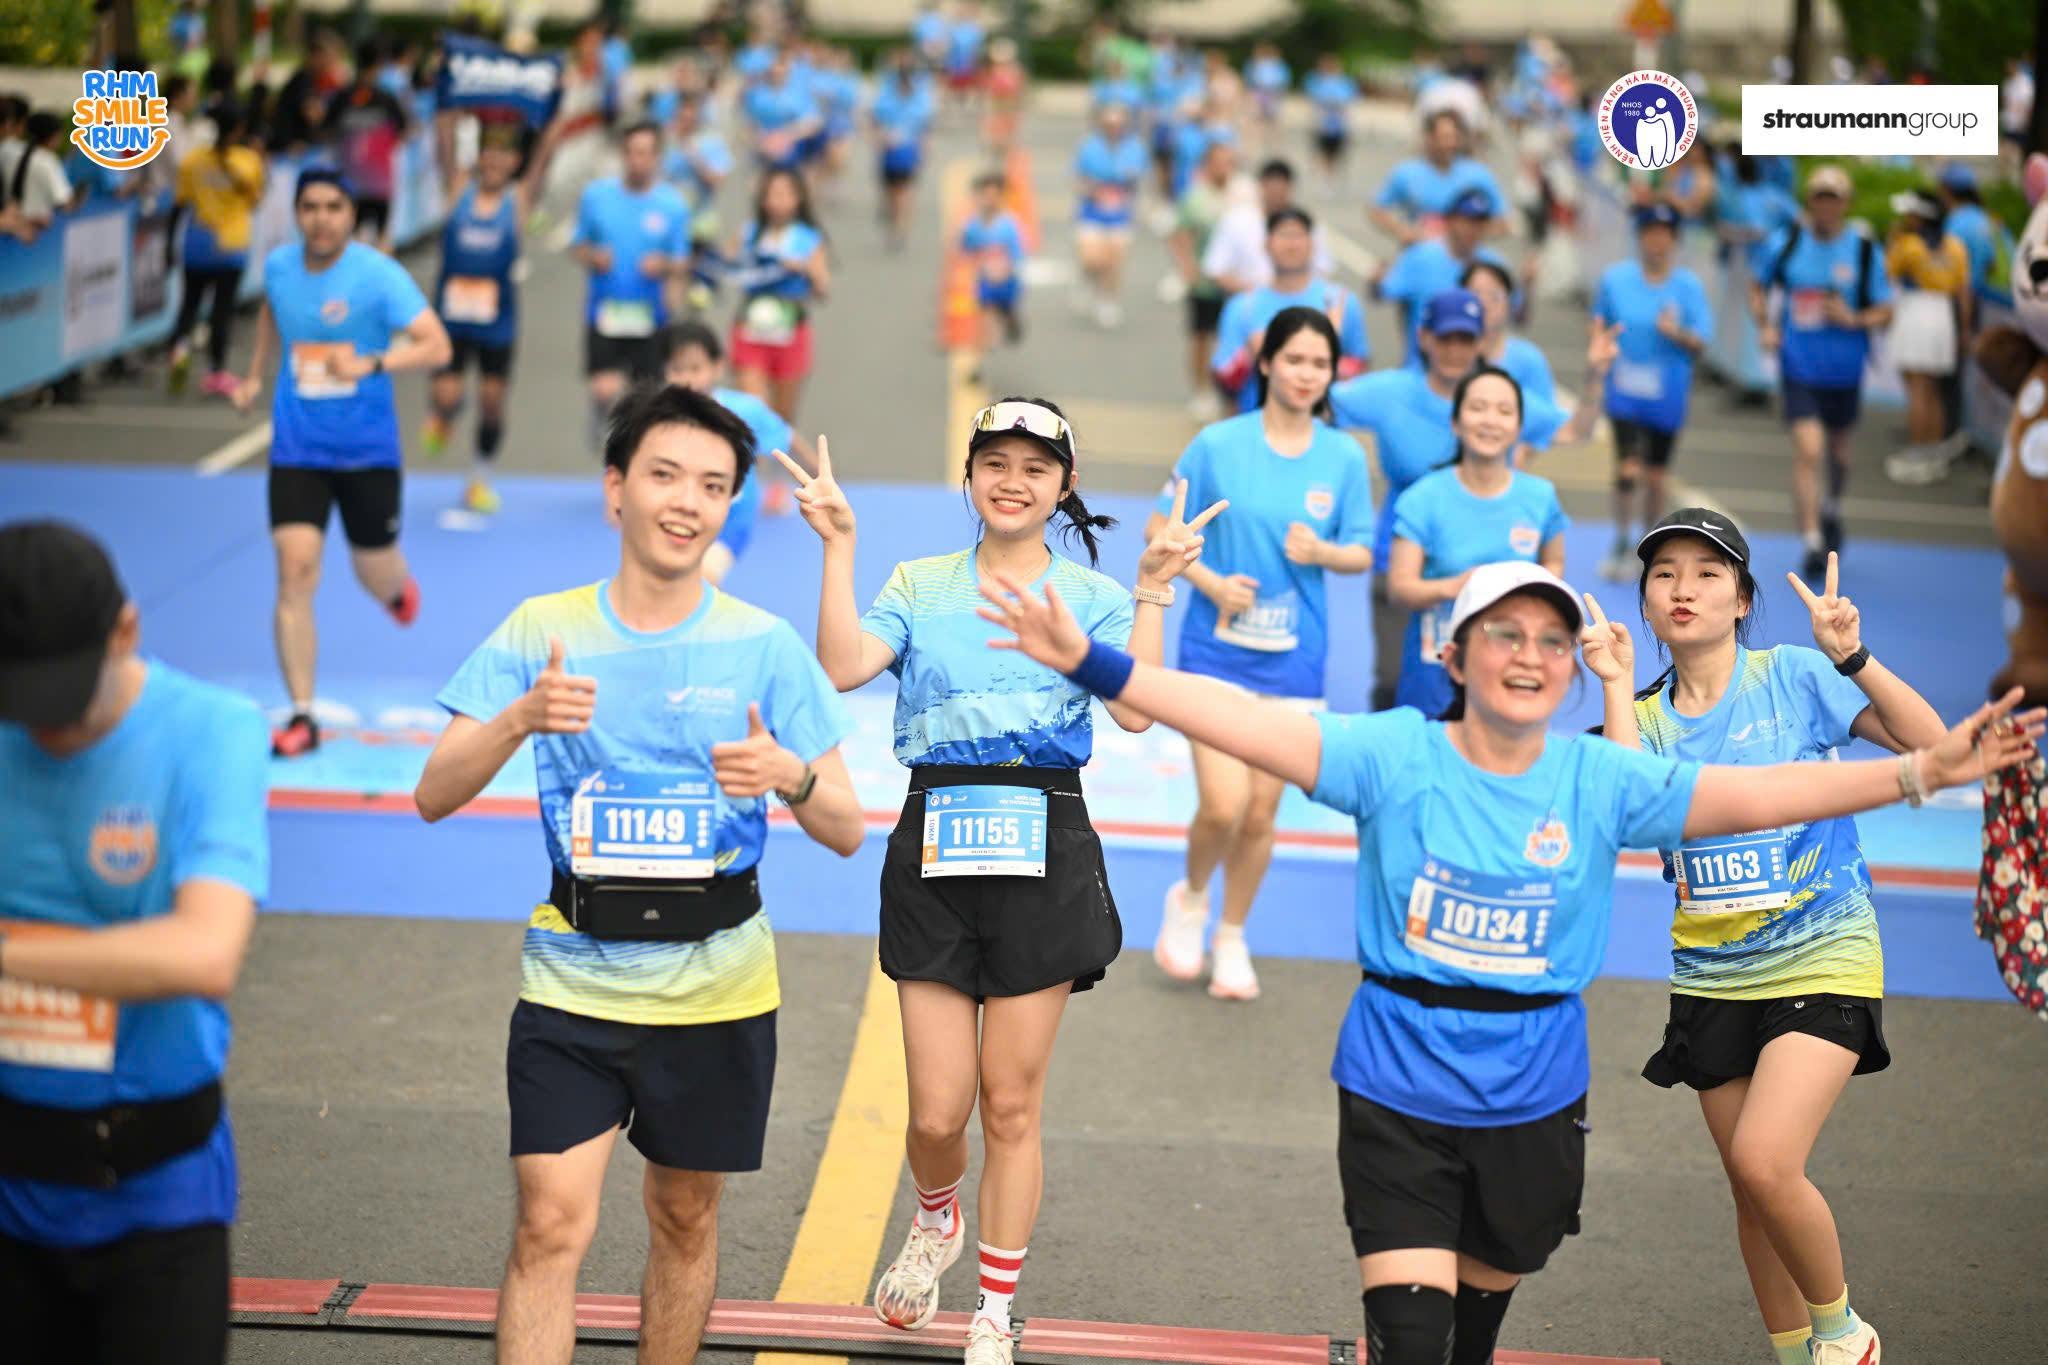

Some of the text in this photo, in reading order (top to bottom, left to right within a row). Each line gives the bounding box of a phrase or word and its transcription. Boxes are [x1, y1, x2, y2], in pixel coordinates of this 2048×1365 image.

[605, 807, 686, 843] 11149
[951, 817, 1020, 845] 11155
[575, 841, 590, 855] M
[926, 849, 934, 861] F
[1692, 850, 1761, 884] 11163
[1442, 898, 1528, 942] 10134
